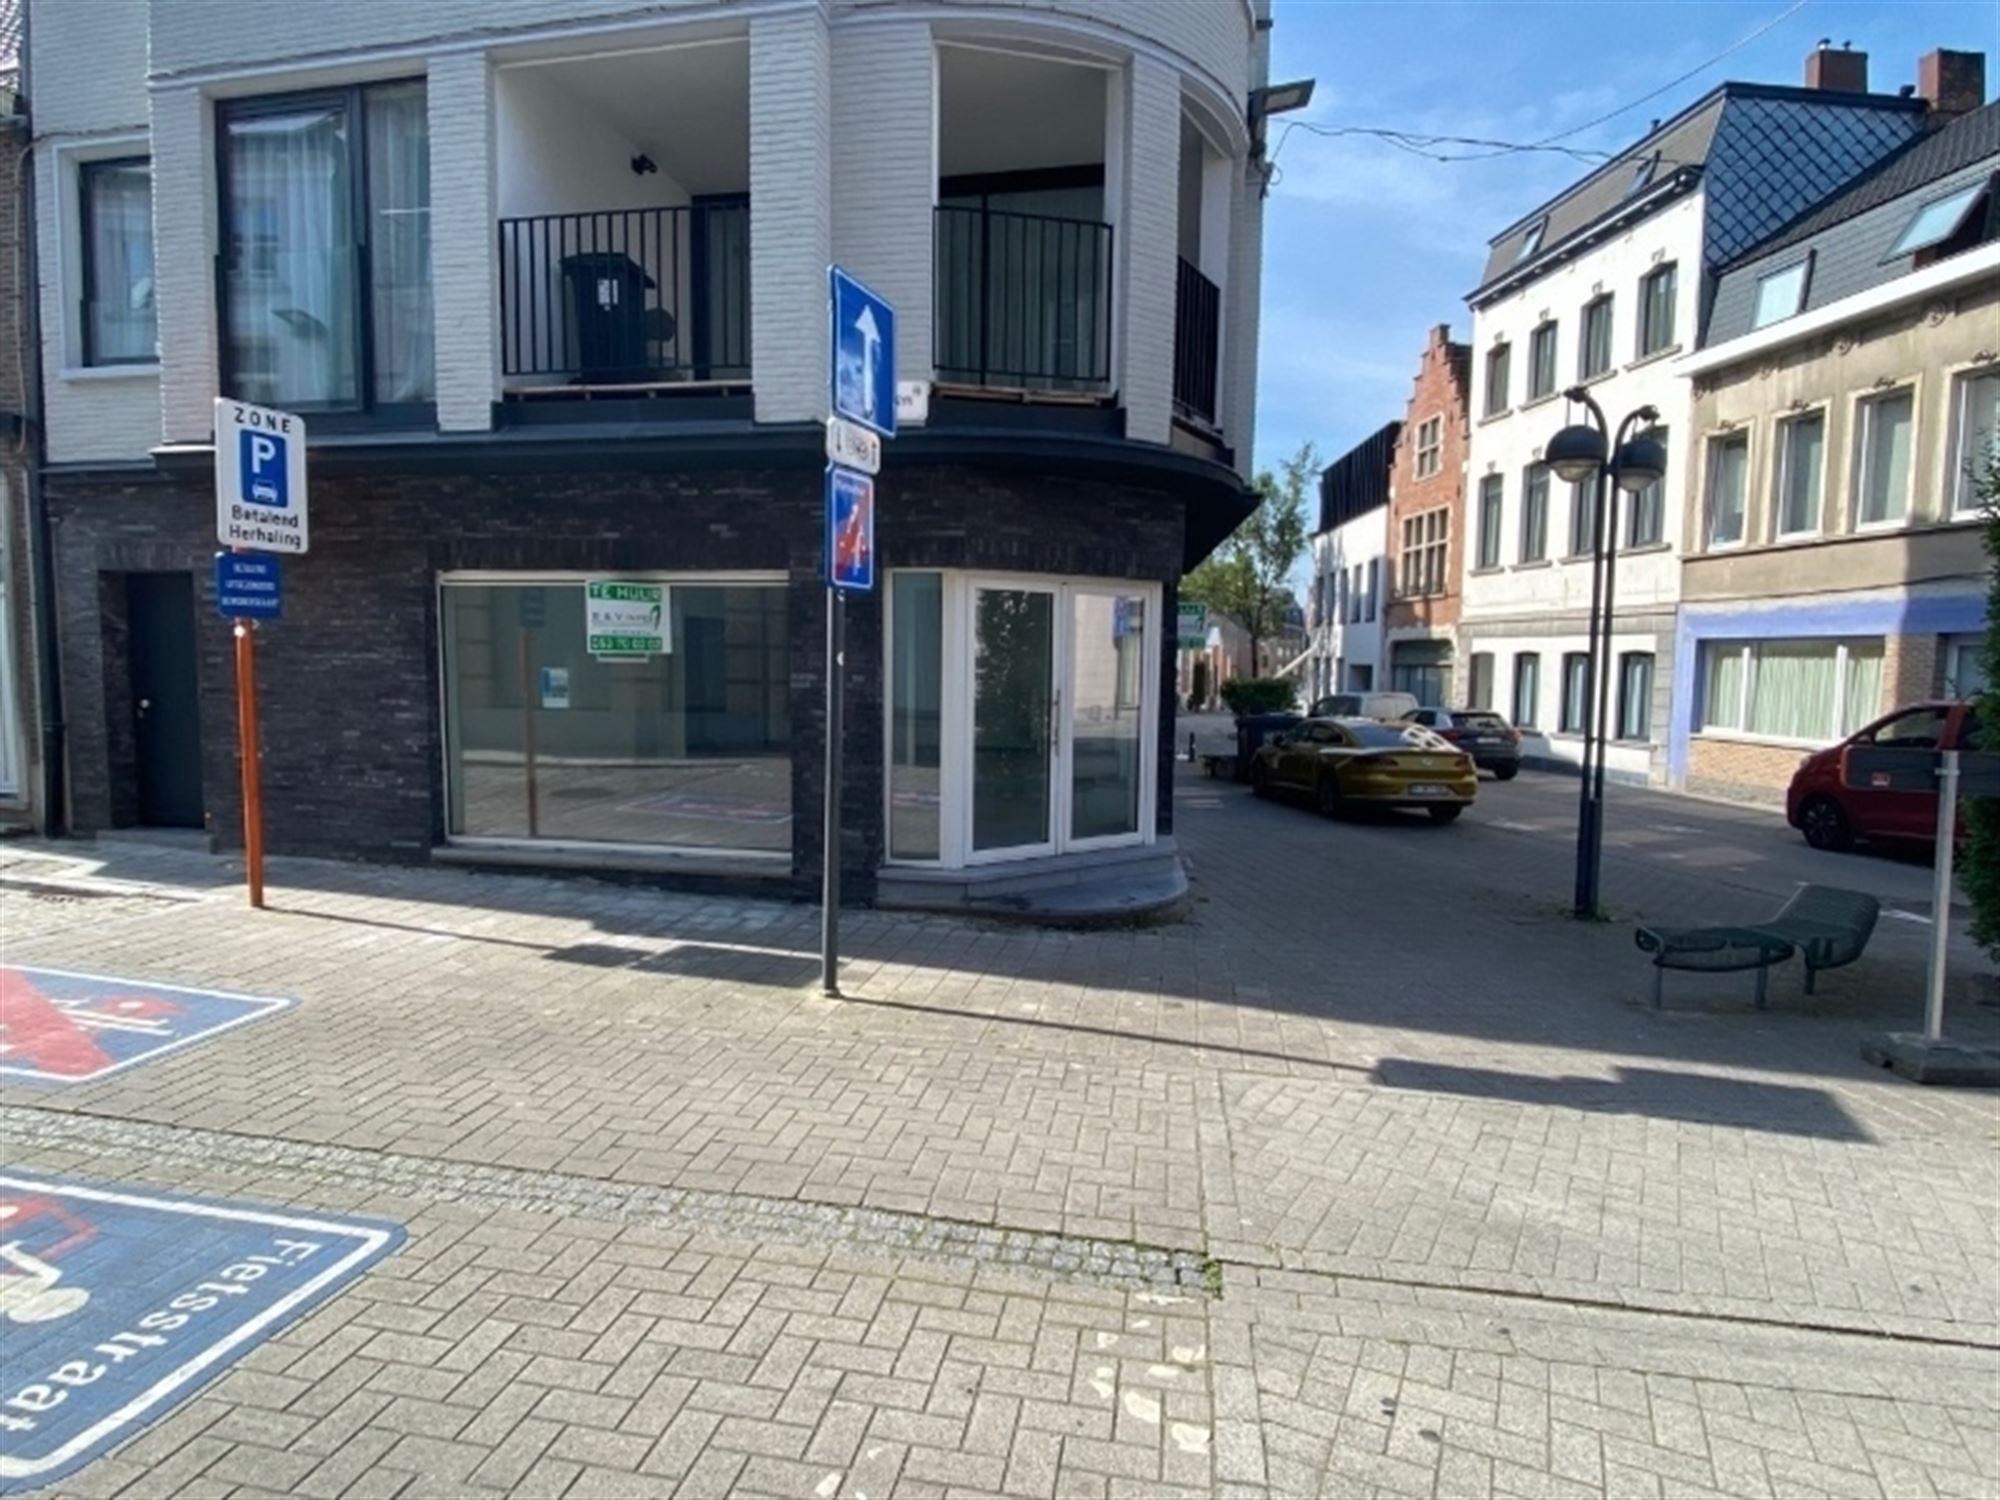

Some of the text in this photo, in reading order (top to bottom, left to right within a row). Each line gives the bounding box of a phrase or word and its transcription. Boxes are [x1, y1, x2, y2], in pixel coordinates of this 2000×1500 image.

[234, 406, 291, 433] ZONE
[252, 435, 276, 474] P
[232, 504, 298, 529] Betalend
[229, 525, 301, 550] Herhaling
[591, 583, 661, 601] TE HUUR
[0, 1238, 321, 1431] Fietsstraat
